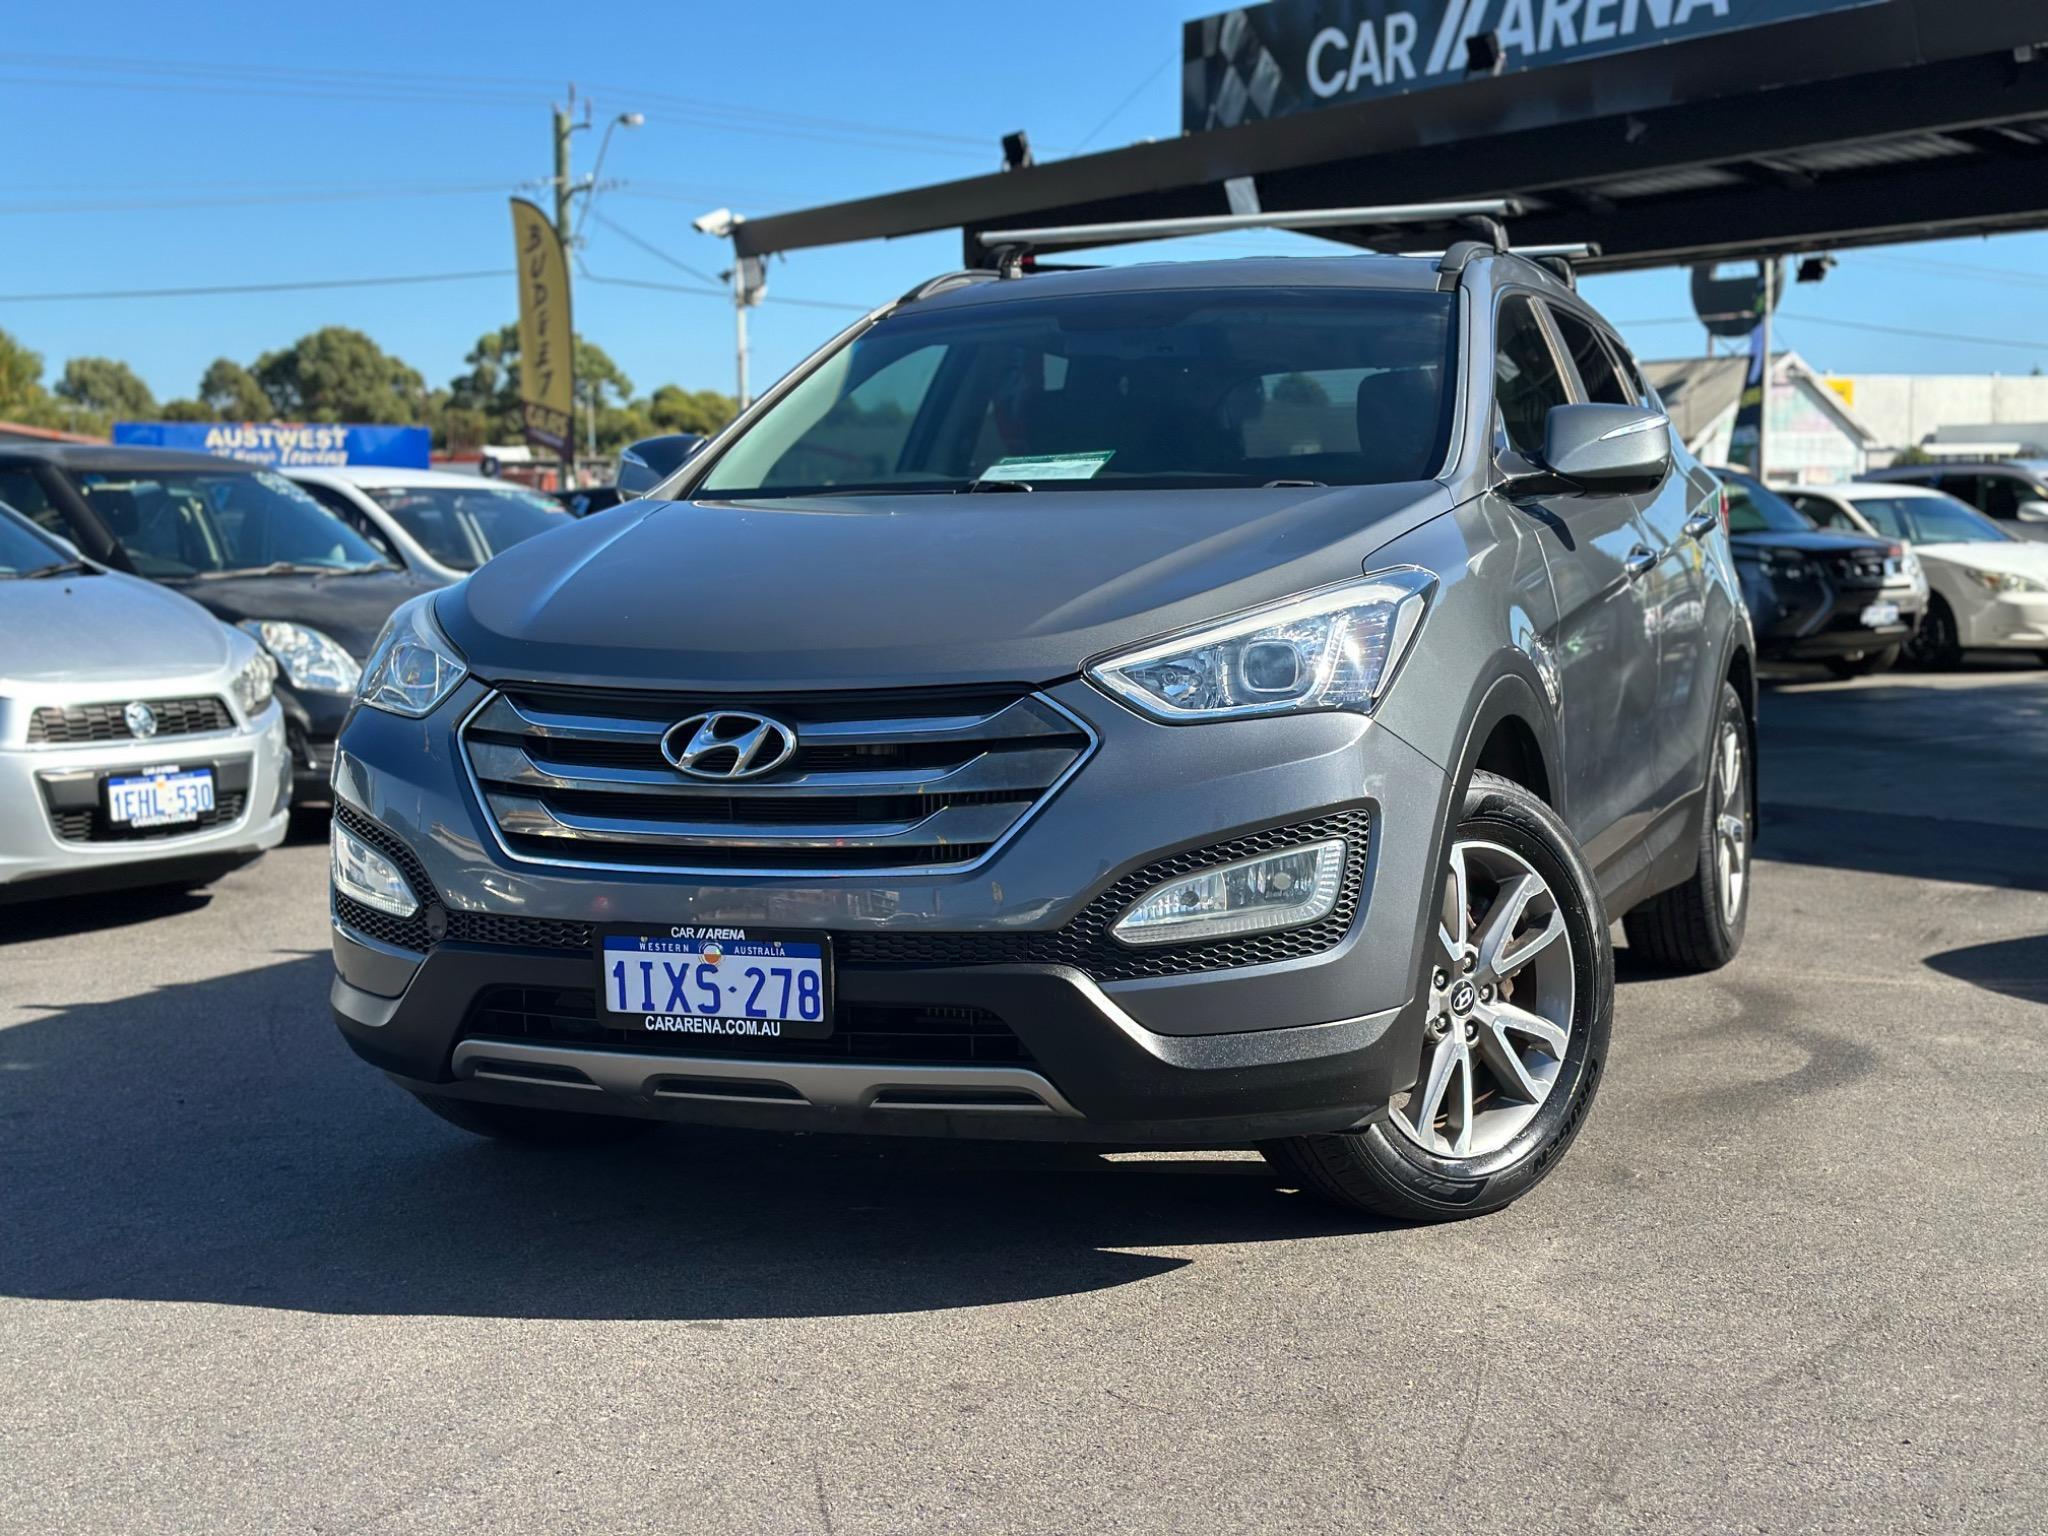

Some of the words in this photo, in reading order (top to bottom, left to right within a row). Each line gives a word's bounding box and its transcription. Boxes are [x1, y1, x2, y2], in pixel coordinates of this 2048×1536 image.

[1306, 11, 1418, 98] CAR
[205, 426, 348, 449] AUSTWEST
[671, 926, 695, 939] CAR
[705, 927, 746, 941] ARENA
[639, 942, 690, 953] WESTERN
[734, 945, 786, 957] AUSTRALIA
[645, 1015, 781, 1037] CARARENA.COM.AU
